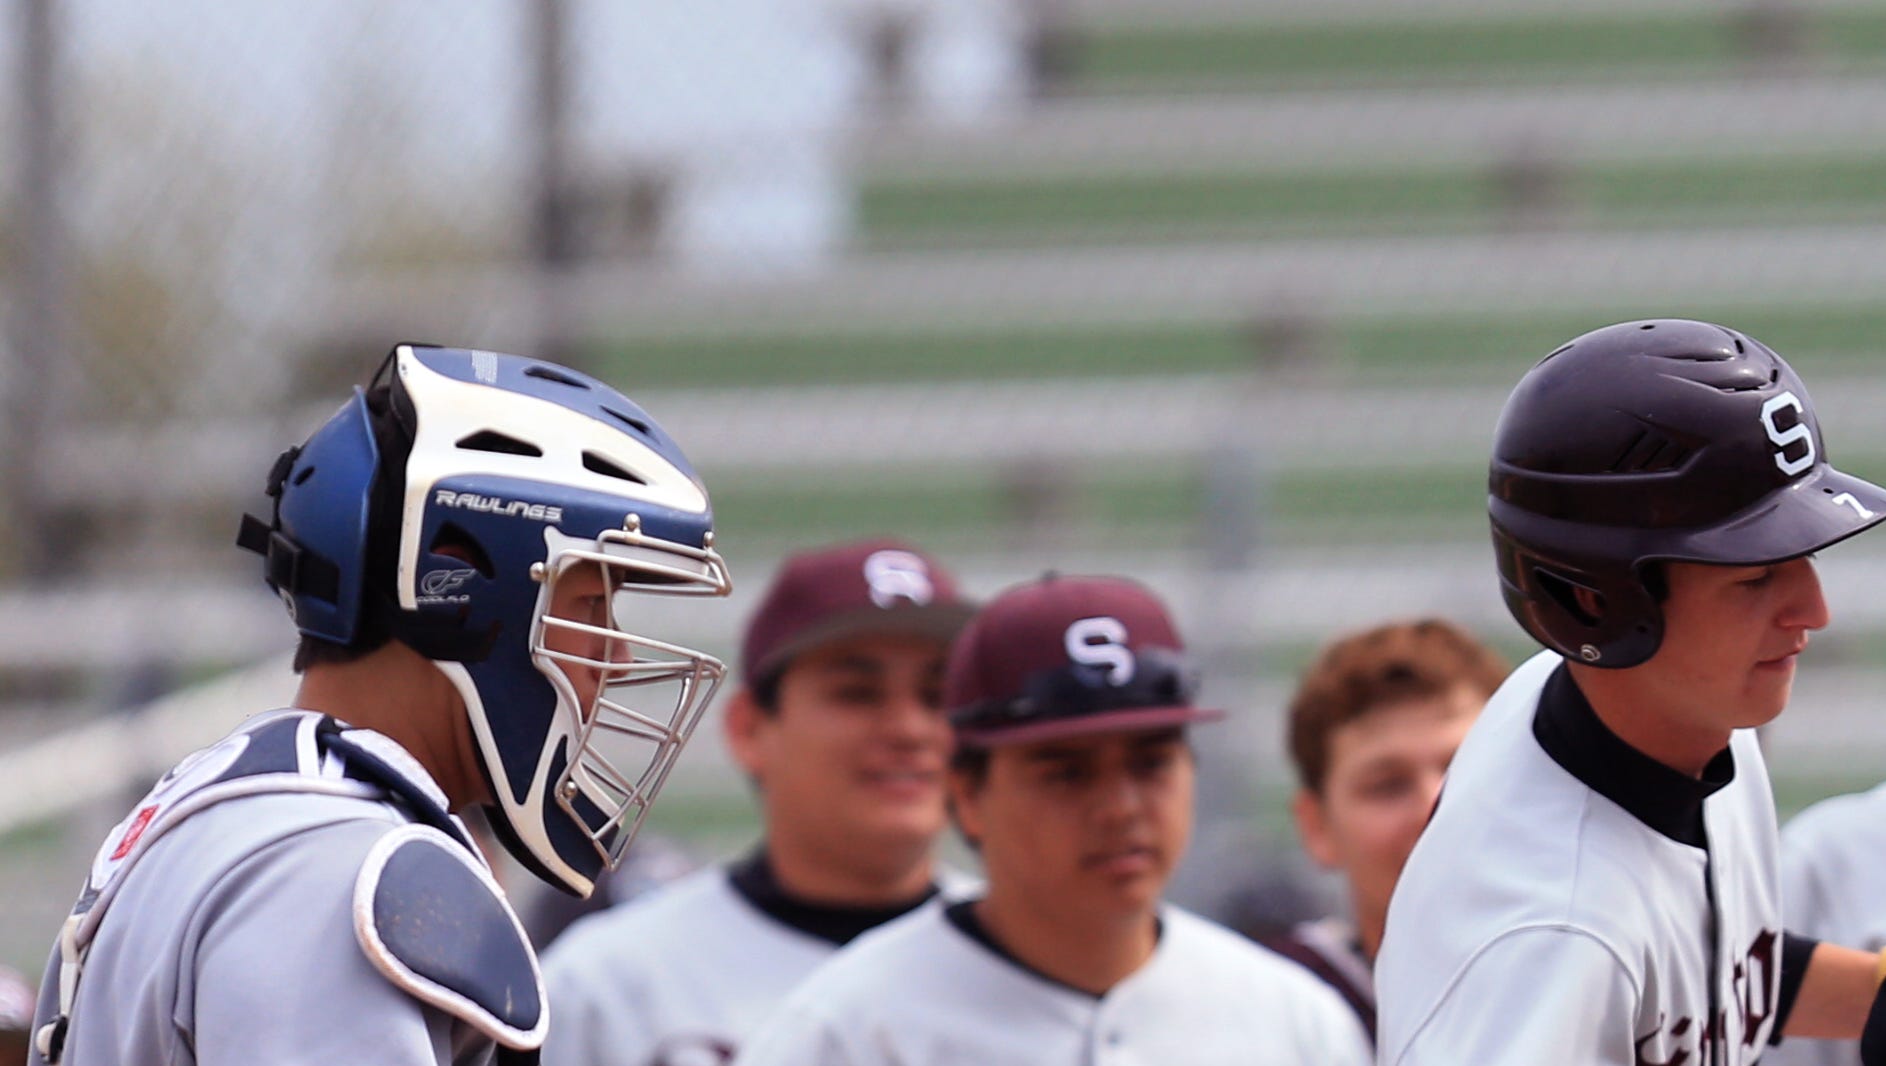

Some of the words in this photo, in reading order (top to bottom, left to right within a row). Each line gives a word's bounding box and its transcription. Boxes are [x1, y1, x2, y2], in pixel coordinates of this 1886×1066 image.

[1760, 391, 1816, 477] S
[435, 489, 563, 521] RAWLINGS
[1831, 492, 1874, 520] 7
[1064, 616, 1136, 688] S
